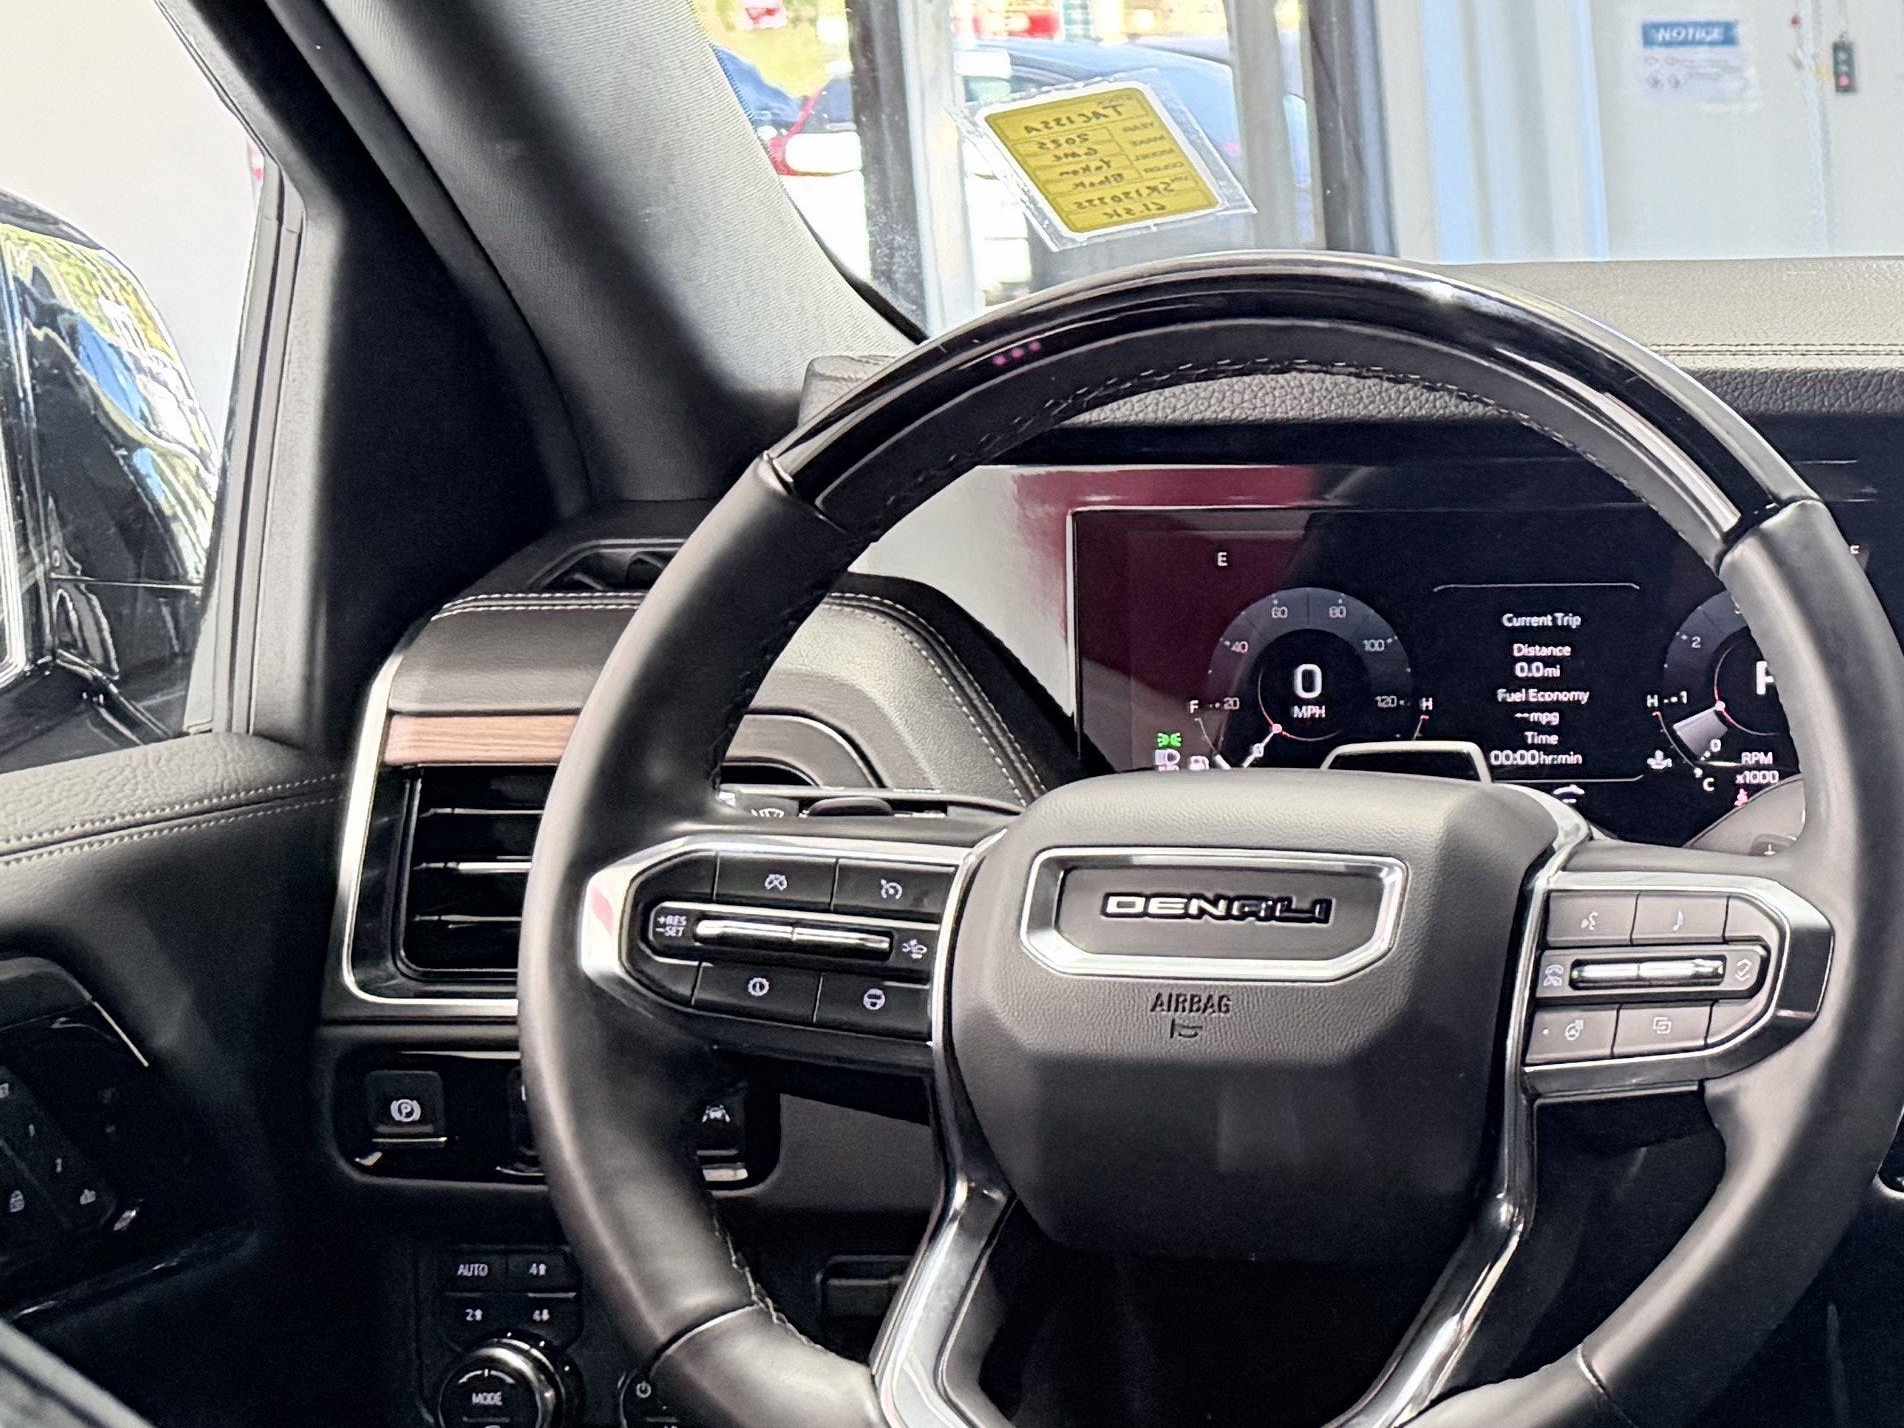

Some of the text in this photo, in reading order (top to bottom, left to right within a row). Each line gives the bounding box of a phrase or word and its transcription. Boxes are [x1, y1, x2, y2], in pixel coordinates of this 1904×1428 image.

[1217, 552, 1228, 566] E
[1502, 613, 1581, 629] Current Trip
[1230, 641, 1249, 654] 40
[1362, 639, 1385, 652] 100
[1691, 636, 1701, 648] 2
[1512, 643, 1571, 657] Distance
[1293, 663, 1322, 699] 0
[1375, 695, 1397, 708] 120
[1497, 688, 1590, 704] Fuel Economy
[1647, 694, 1659, 708] H
[1680, 690, 1688, 704] 1
[1189, 700, 1199, 714] F
[1223, 697, 1240, 710] 20
[1419, 697, 1432, 710] H
[1293, 705, 1326, 719] MPH
[1524, 731, 1559, 745] Time
[1741, 752, 1773, 765] RPM
[1735, 770, 1779, 784] x1000
[1703, 778, 1715, 792] C
[1101, 892, 1332, 924] DENALI
[1151, 992, 1232, 1015] AIRBAG
[457, 1263, 489, 1277] AUTO
[471, 1392, 503, 1406] MODE
